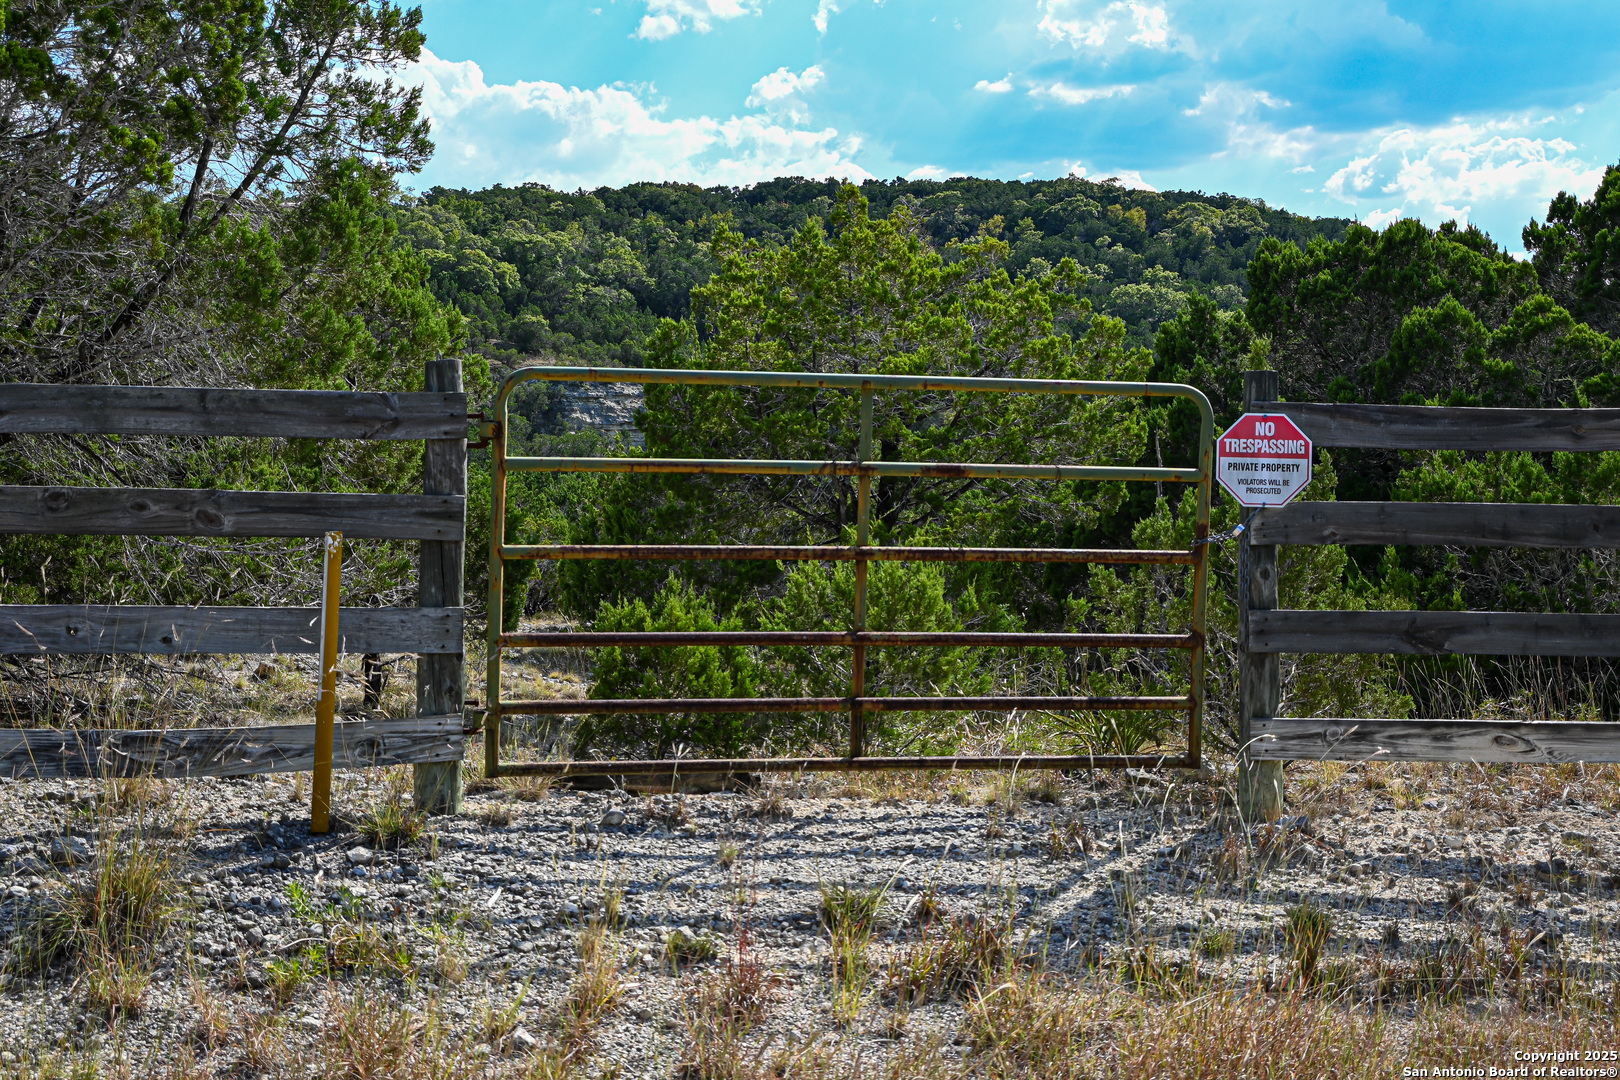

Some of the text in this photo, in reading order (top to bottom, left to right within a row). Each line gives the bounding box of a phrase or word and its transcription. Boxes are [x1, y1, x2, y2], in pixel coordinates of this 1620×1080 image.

[1255, 421, 1275, 437] NO
[1224, 438, 1305, 454] TRESPASSING
[1228, 462, 1300, 472] PRIVATE PROPERTY
[1246, 487, 1282, 495] PROSECUTED
